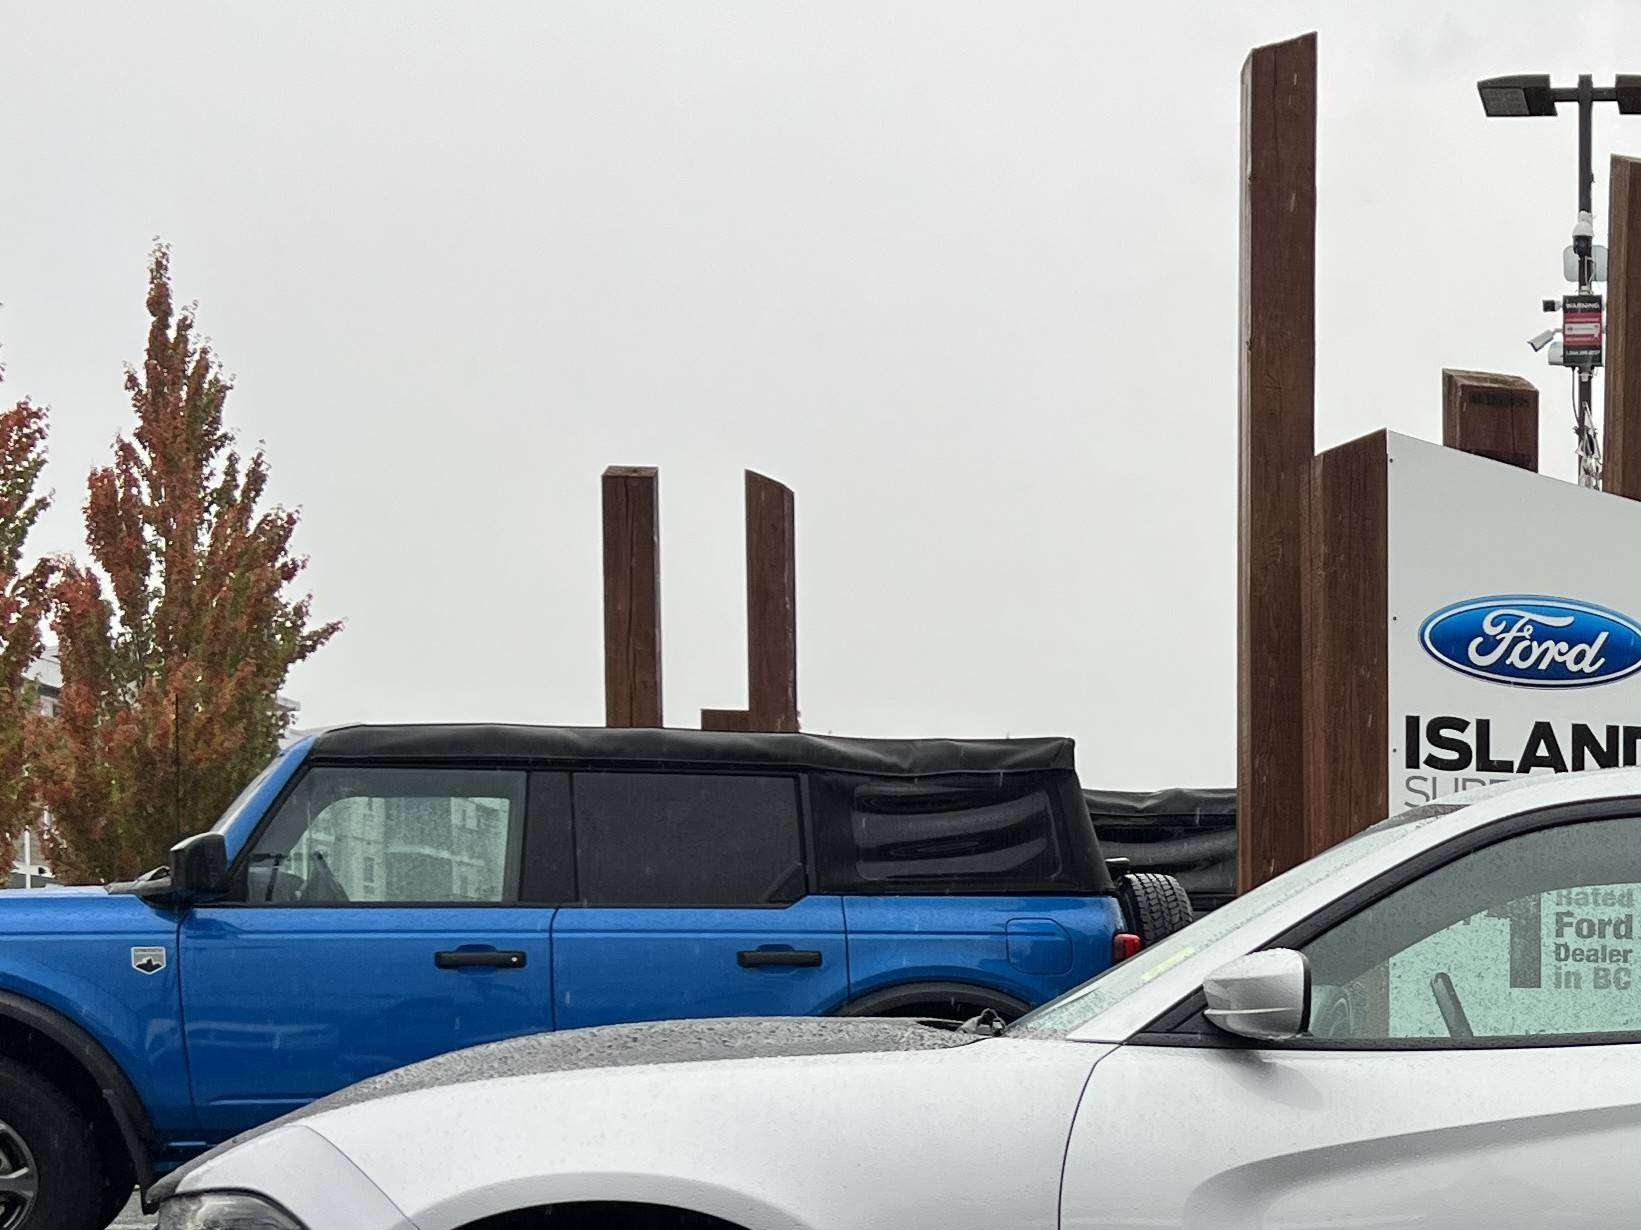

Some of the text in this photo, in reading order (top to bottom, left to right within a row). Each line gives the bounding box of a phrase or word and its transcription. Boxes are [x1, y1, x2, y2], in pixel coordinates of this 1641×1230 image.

[1468, 608, 1610, 674] Ford
[1556, 888, 1633, 908] Rated
[1555, 911, 1633, 940] Ford
[1554, 943, 1633, 963] Dealer
[1554, 965, 1632, 990] in BC
